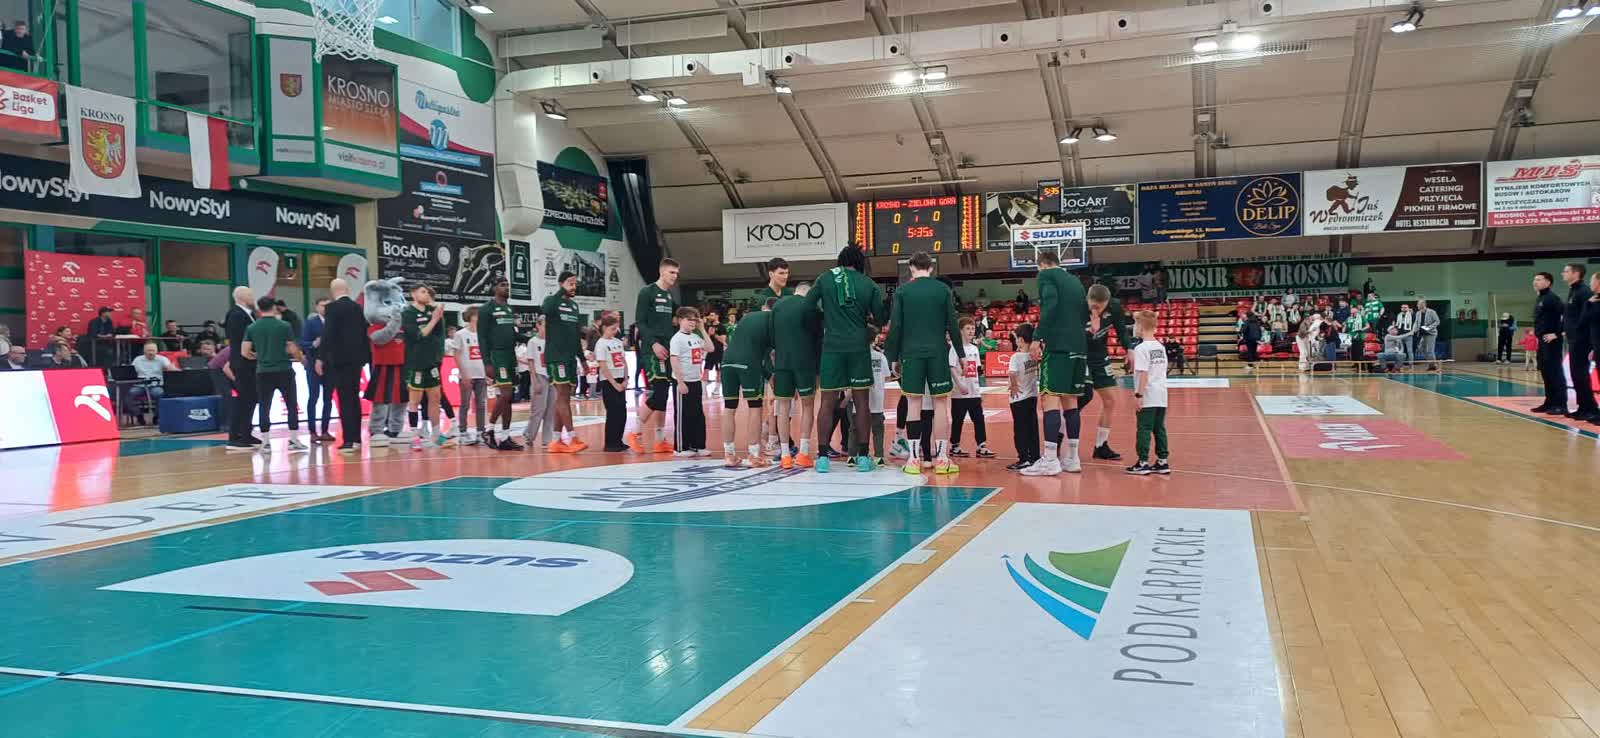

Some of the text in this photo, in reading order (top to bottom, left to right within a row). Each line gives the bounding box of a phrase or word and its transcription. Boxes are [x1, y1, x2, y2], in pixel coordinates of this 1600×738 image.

[12, 90, 47, 106] Basket
[327, 75, 390, 108] KROSNO
[12, 103, 34, 115] Liga
[80, 107, 124, 123] KROSNO
[0, 171, 89, 202] owySty
[1419, 185, 1463, 193] CATERINGI
[150, 190, 231, 218] NowyStyl
[876, 201, 900, 209] KROSNO
[1419, 195, 1462, 203] PRZYJĘCIA
[1243, 206, 1295, 221] DELIP
[1438, 203, 1477, 211] FIRMOWE
[276, 207, 340, 231] NowyStyl
[893, 213, 901, 224] 0
[933, 210, 941, 221] 0
[1094, 216, 1131, 227] SREBRO
[747, 221, 825, 242] krosno
[1032, 229, 1077, 239] SUZUKI
[892, 240, 941, 254] 0 0
[1167, 262, 1348, 289] MOSIR KROSNO
[315, 549, 589, 569] SUZUKI
[1112, 526, 1207, 687] PODKARPACKIE
